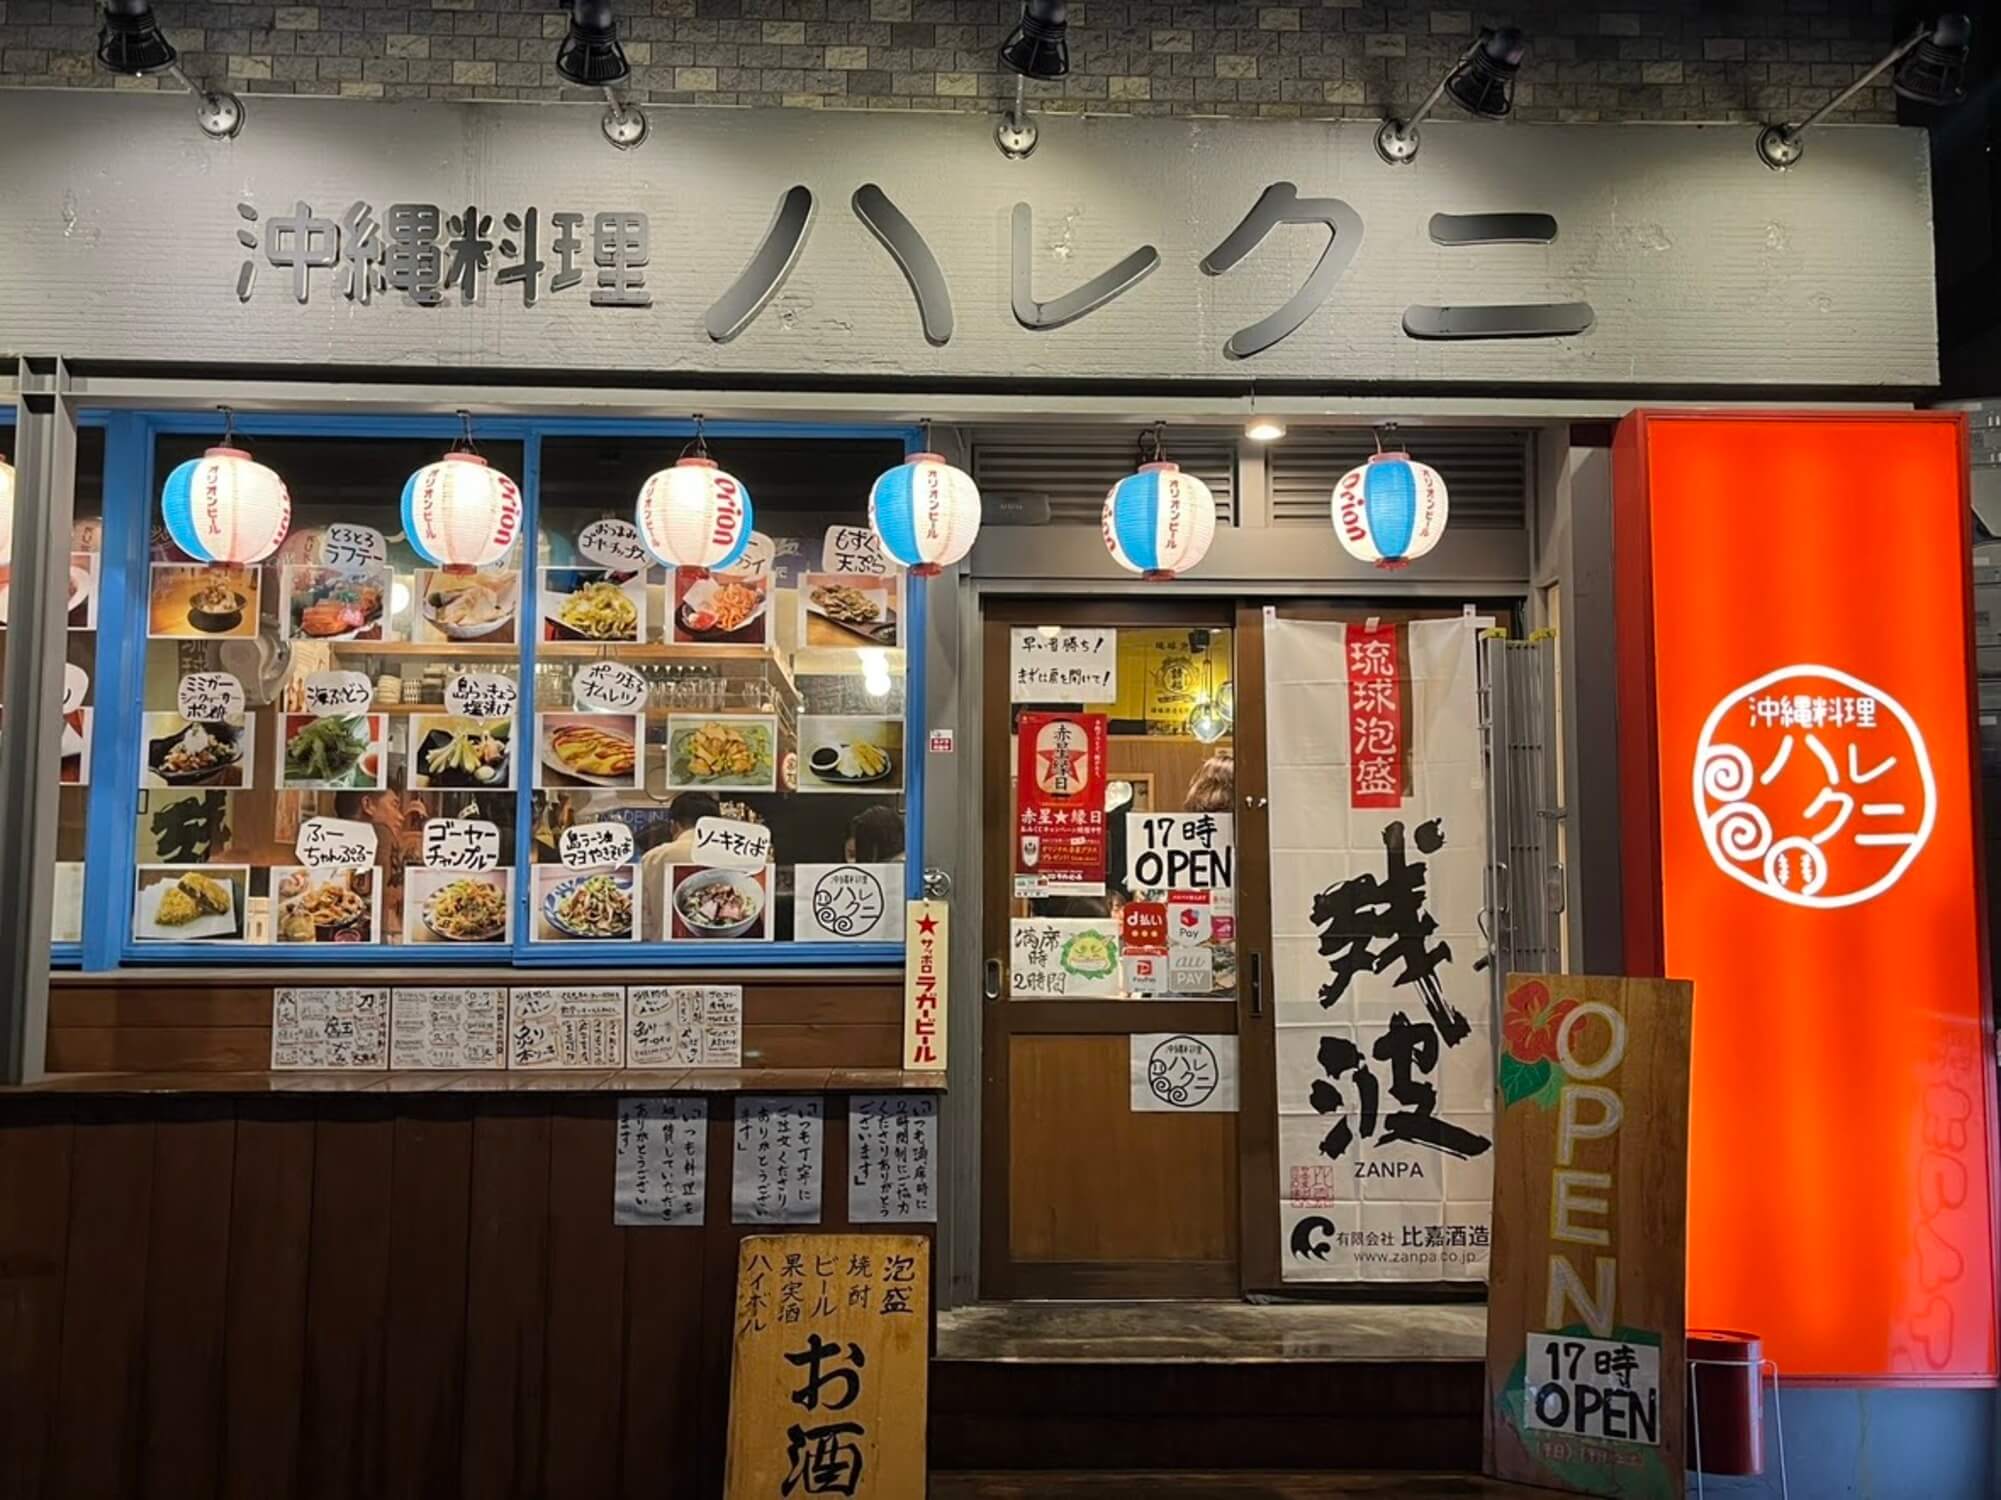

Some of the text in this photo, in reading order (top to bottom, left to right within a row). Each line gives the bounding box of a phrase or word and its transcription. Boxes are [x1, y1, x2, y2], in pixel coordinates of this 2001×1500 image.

[236, 183, 1597, 360] 沖縄料理 ハレクニ
[207, 465, 222, 535] オリオンビール
[424, 469, 440, 539] オリオンビール
[494, 476, 522, 546] Orion
[712, 477, 742, 546] Orion
[926, 469, 940, 540] オリオンビール
[1165, 480, 1180, 549] オリオンビール
[1339, 472, 1367, 542] Orion
[1418, 469, 1430, 537] オリオンビール
[325, 543, 383, 566] ラフテー
[835, 553, 886, 573] 天ぷら
[187, 675, 234, 691] ミミガー
[307, 684, 369, 704] 海ぶどう
[581, 680, 637, 706] オムレツ
[1350, 640, 1396, 795] 琉球泡盛
[1749, 696, 1876, 728] 沖縄料理
[1760, 733, 1897, 784] ハレ
[307, 824, 345, 842] ふー
[428, 821, 497, 845] ゴーヤー
[1144, 815, 1217, 849] 17時
[1803, 786, 1915, 846] クニ
[426, 848, 497, 870] チャンプルー
[697, 829, 768, 857] ソーキそば
[1135, 846, 1232, 888] OPEN
[833, 886, 874, 901] ハレ
[845, 900, 880, 919] クニ
[1179, 928, 1199, 938] Pay
[1176, 972, 1204, 985] PAY
[1168, 1056, 1208, 1071] ハレ
[1180, 1072, 1214, 1090] クニ
[1354, 1161, 1424, 1178] ZANPA
[1546, 1001, 1628, 1339] OPEN
[1336, 1225, 1489, 1248] 有限会社 比嘉酒造
[738, 1254, 773, 1335] ハイボール
[778, 1253, 806, 1324] 果実酒
[810, 1255, 839, 1317] ビール
[847, 1255, 872, 1308] 焼酎
[880, 1256, 915, 1315] 泡盛
[1545, 1342, 1639, 1388] 17時
[781, 1333, 865, 1497] お酒
[1535, 1382, 1657, 1442] OPEN
